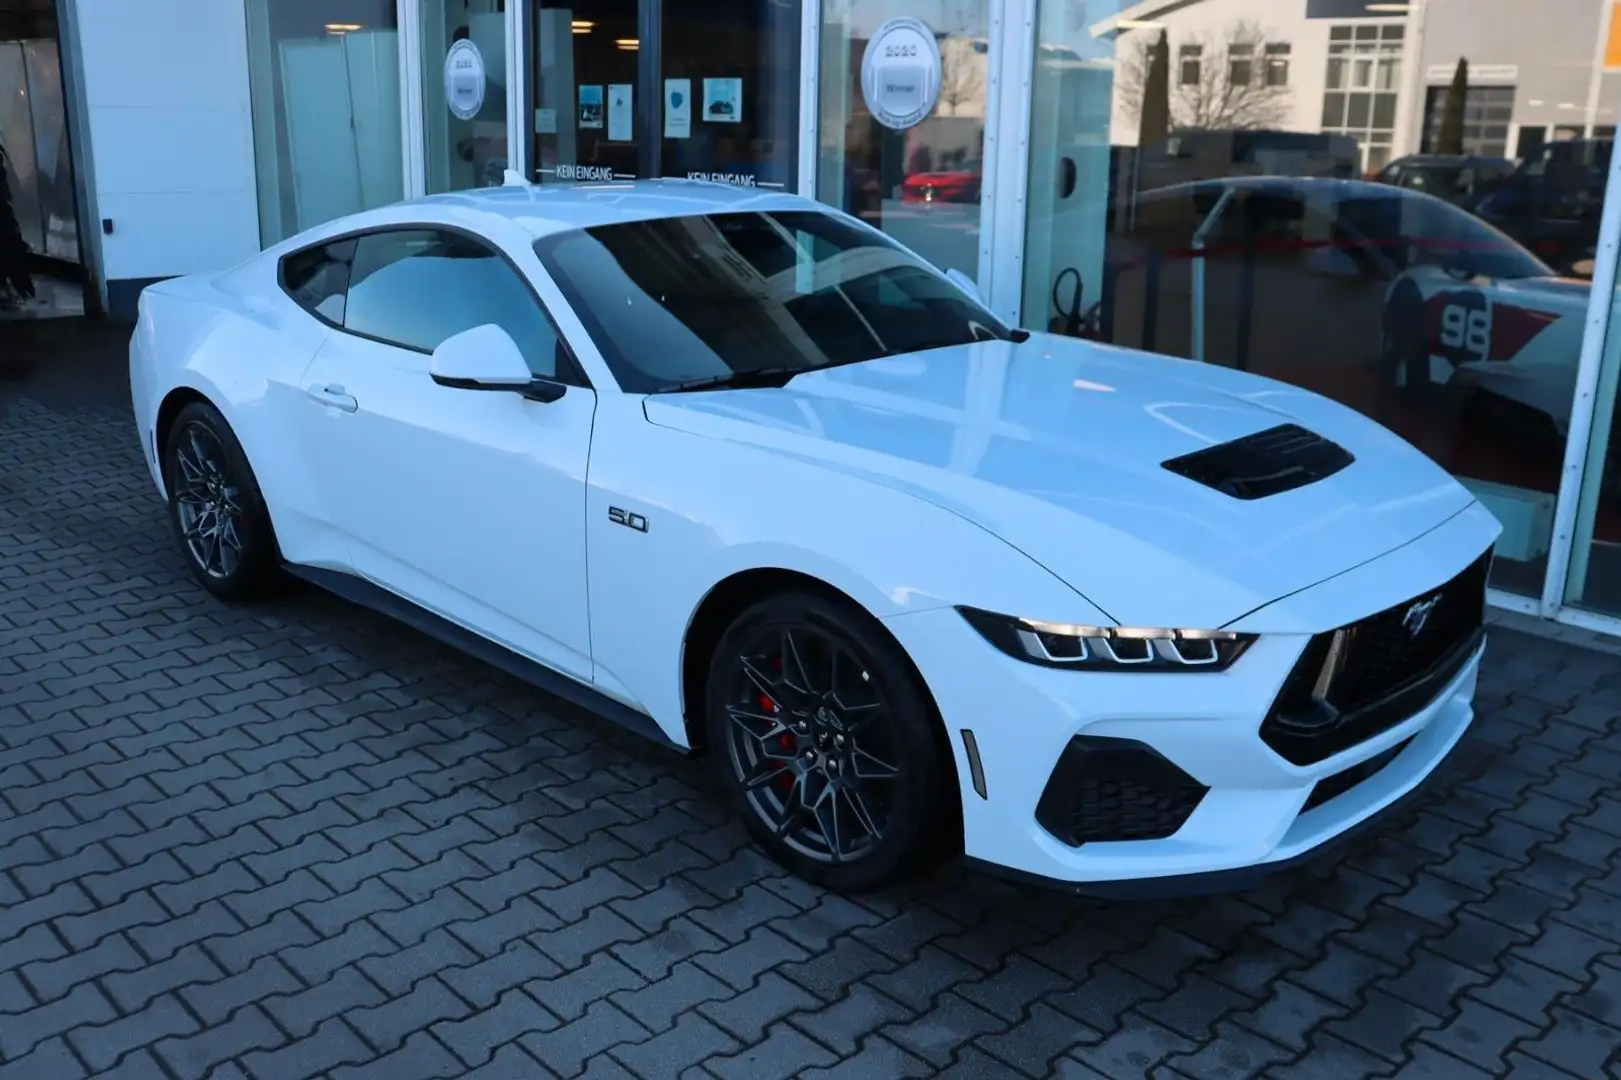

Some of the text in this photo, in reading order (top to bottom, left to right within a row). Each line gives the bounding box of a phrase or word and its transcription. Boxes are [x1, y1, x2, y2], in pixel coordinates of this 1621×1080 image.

[556, 164, 613, 181] KEIN EINGANG
[711, 172, 756, 188] EINGANG
[1441, 304, 1491, 355] 98
